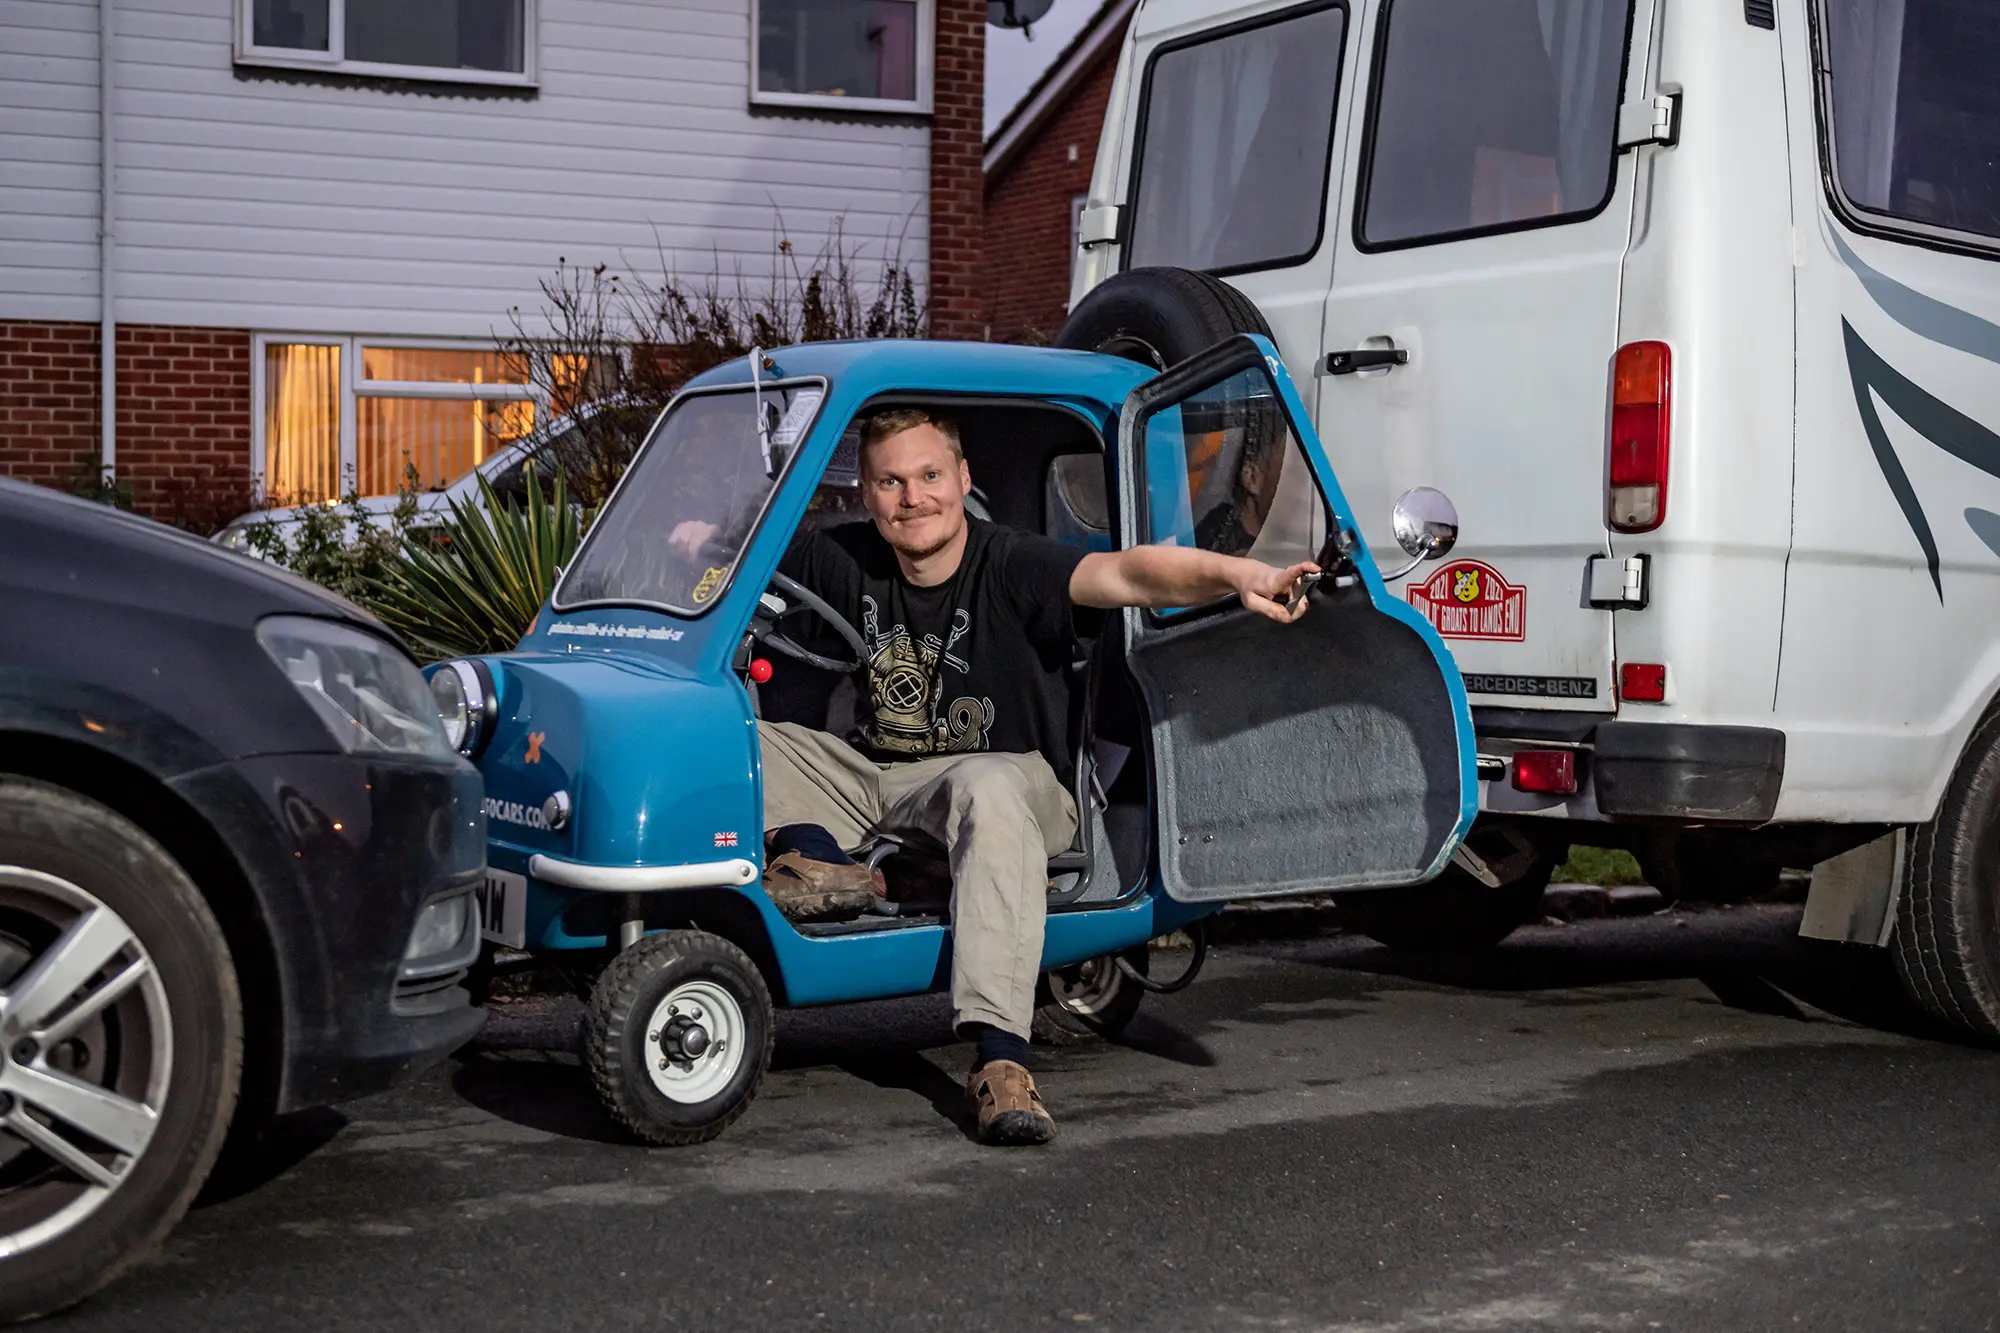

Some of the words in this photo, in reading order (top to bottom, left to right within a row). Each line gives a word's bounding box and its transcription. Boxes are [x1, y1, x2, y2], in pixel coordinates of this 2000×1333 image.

[1429, 572, 1448, 600] 2021
[1484, 572, 1503, 601] 2021
[1441, 605, 1467, 632] GROATS
[1469, 607, 1479, 633] TO
[1480, 601, 1504, 634] LANDS
[1504, 592, 1521, 635] END
[1464, 675, 1594, 696] ERCEDES-BENZ
